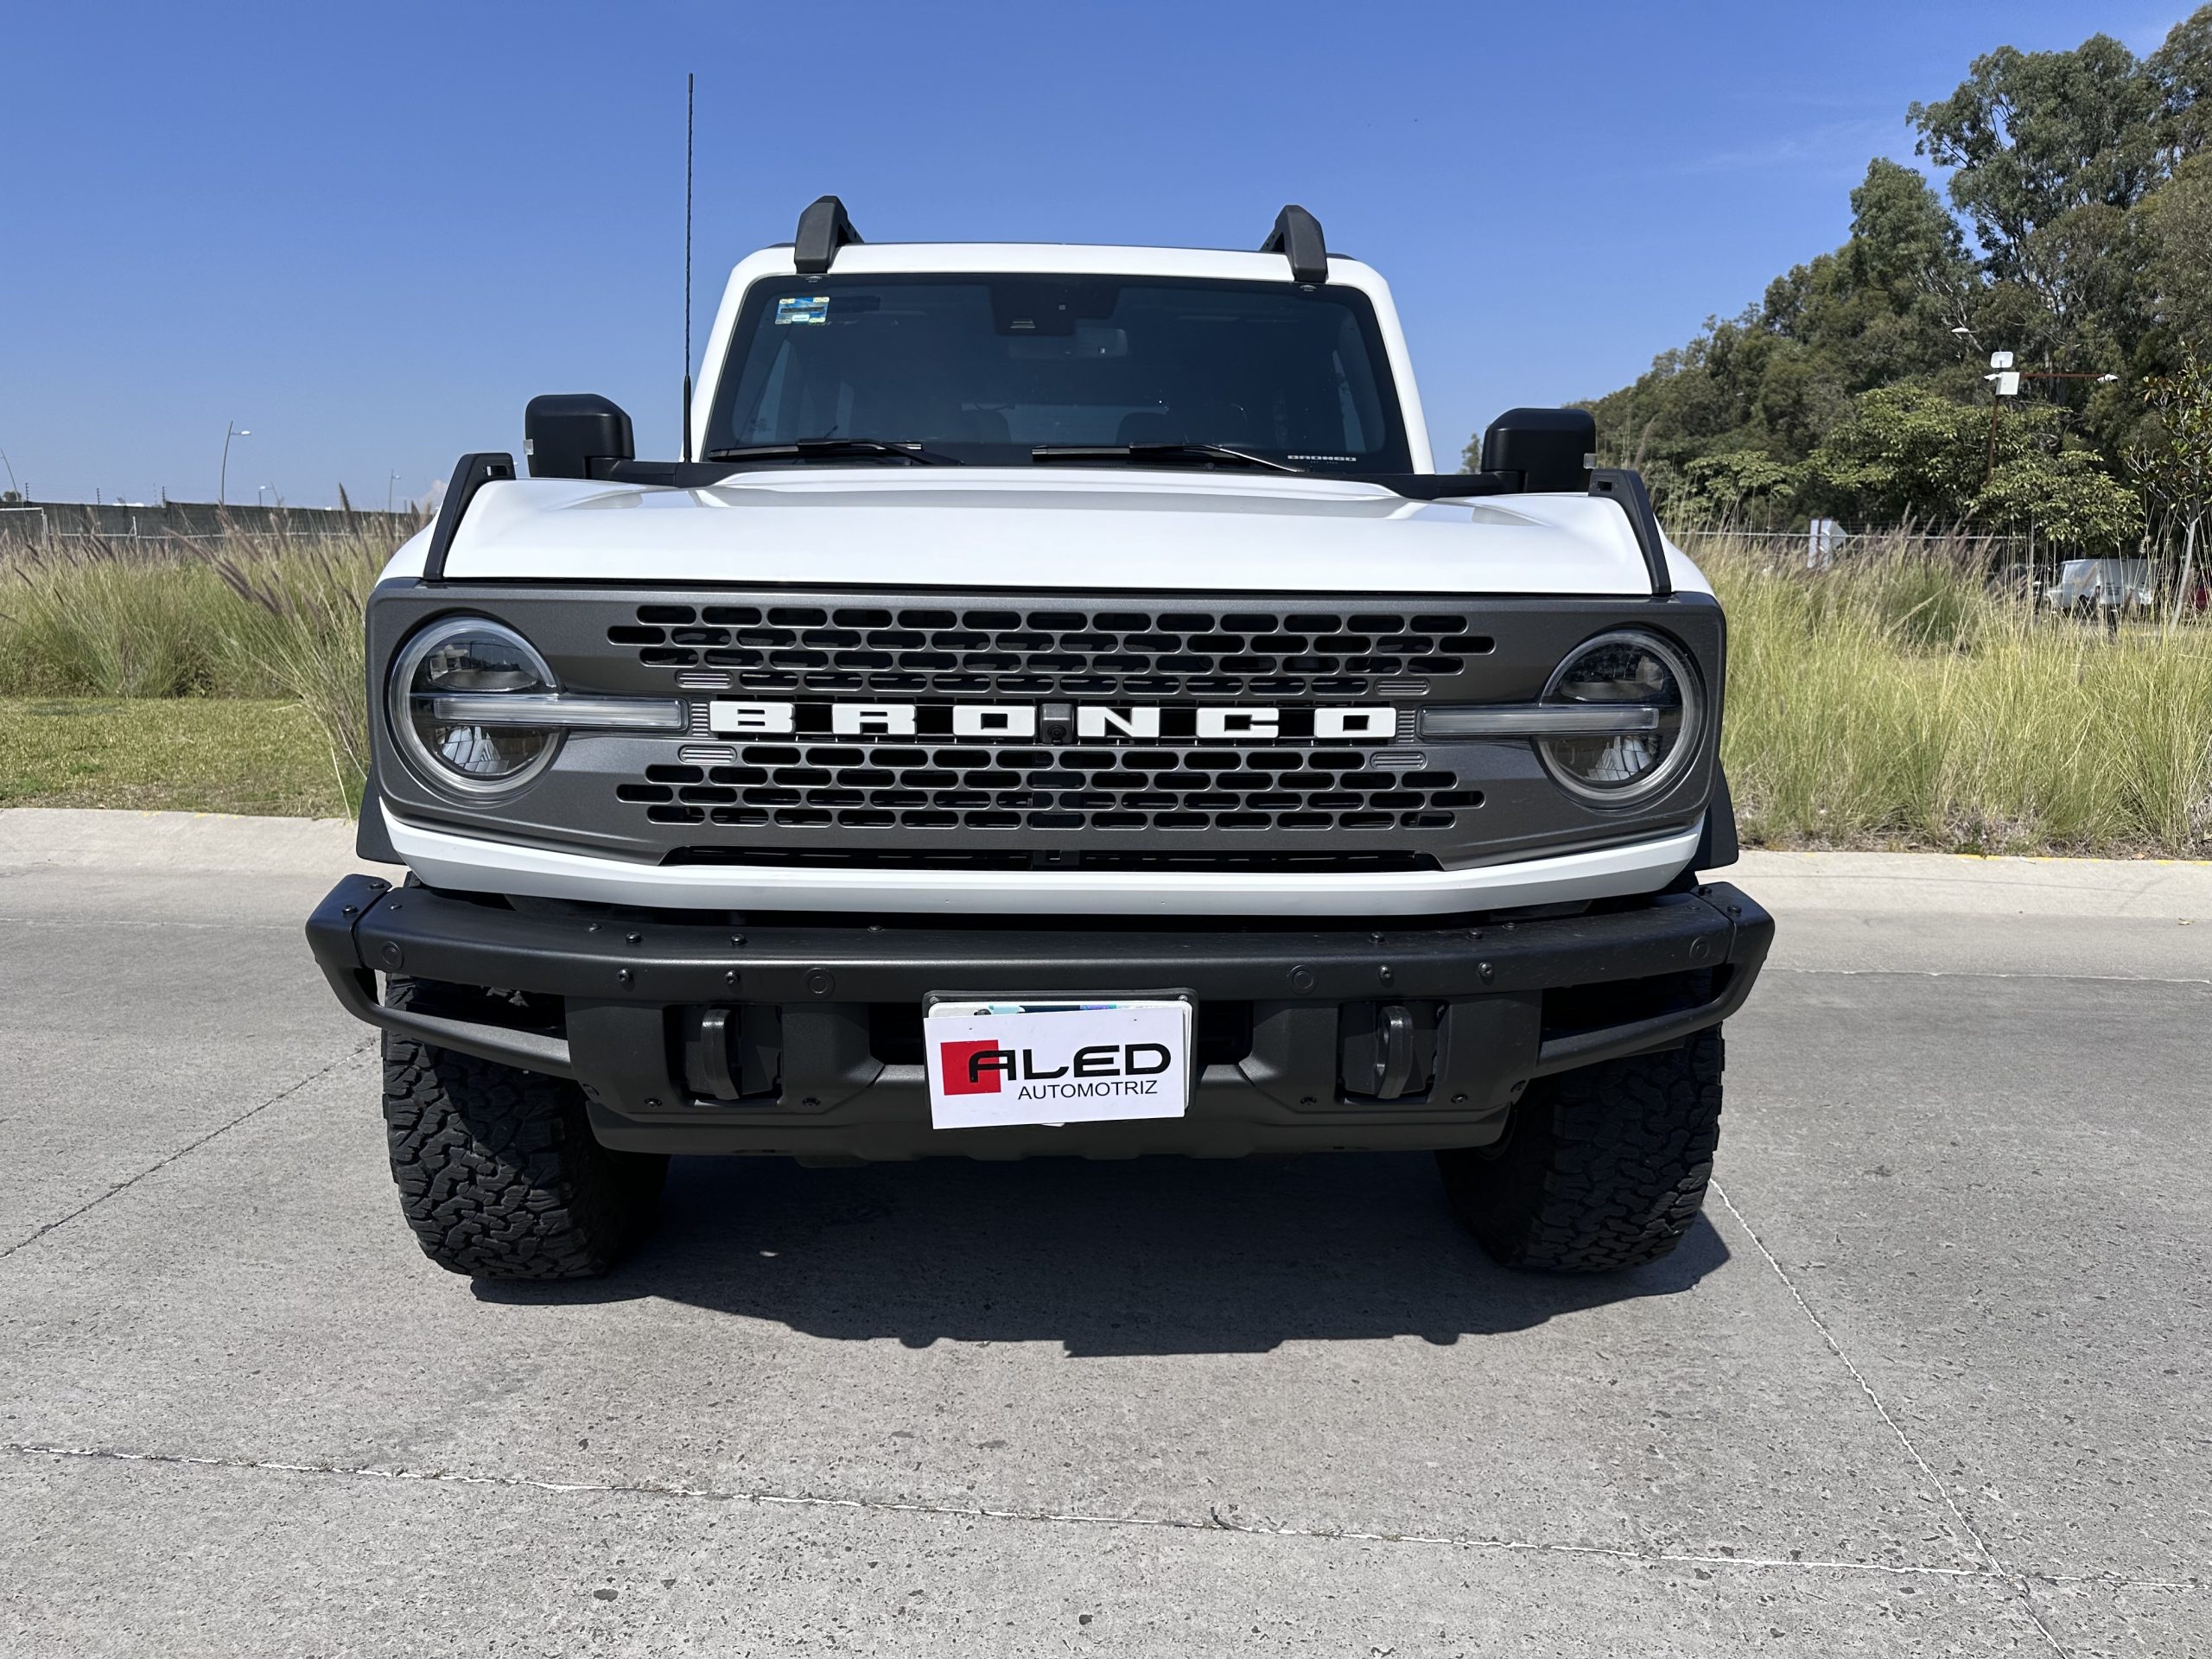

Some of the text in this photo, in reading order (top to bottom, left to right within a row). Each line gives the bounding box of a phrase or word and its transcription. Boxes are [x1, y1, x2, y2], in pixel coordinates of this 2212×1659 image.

[709, 701, 1398, 739] BRONCO
[968, 1042, 1172, 1084] ALED
[1017, 1079, 1158, 1100] AUTOMOTRIZ
